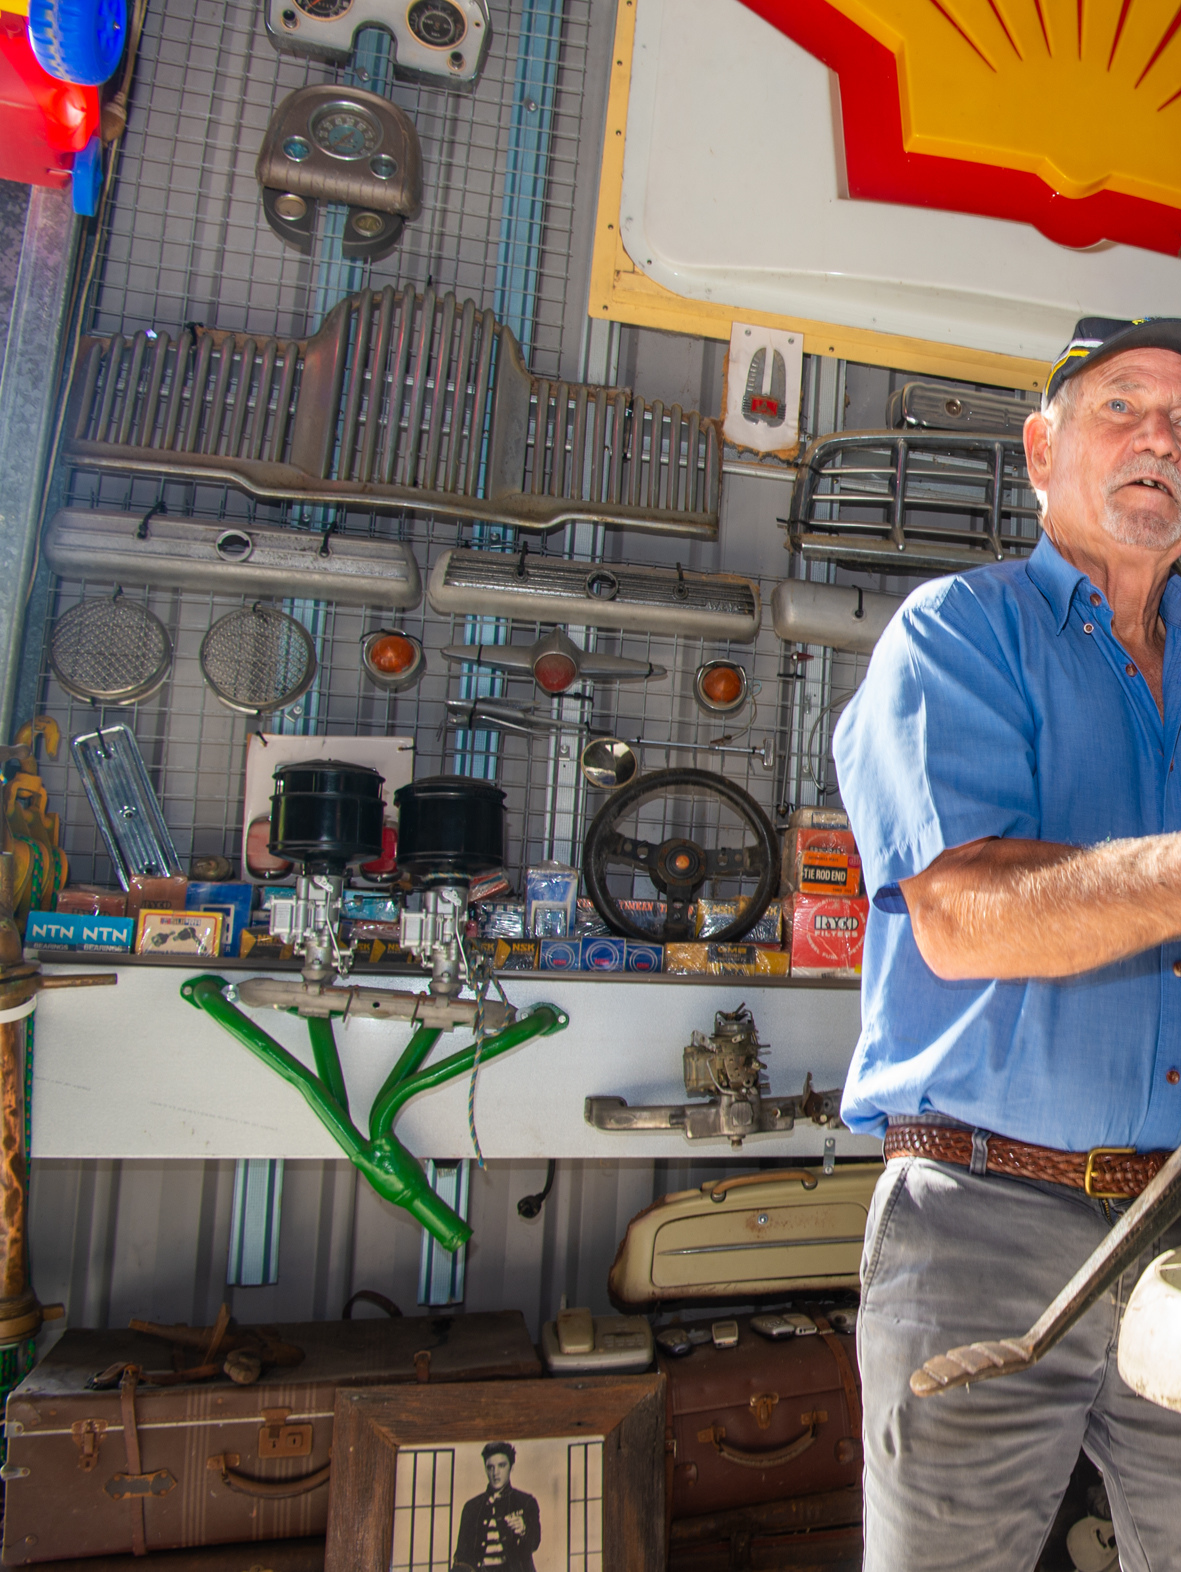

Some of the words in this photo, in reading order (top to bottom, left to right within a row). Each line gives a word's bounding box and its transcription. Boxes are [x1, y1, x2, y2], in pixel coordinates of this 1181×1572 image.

[804, 868, 815, 880] TIE
[815, 869, 831, 881] ROD
[831, 870, 846, 882] END
[619, 901, 653, 911] TIMKEN
[815, 915, 859, 931] RYCO
[32, 923, 74, 940] NTN
[83, 926, 127, 942] NTN
[815, 930, 858, 938] FILTERS
[84, 944, 123, 952] BEARINGS
[512, 943, 535, 952] NSK
